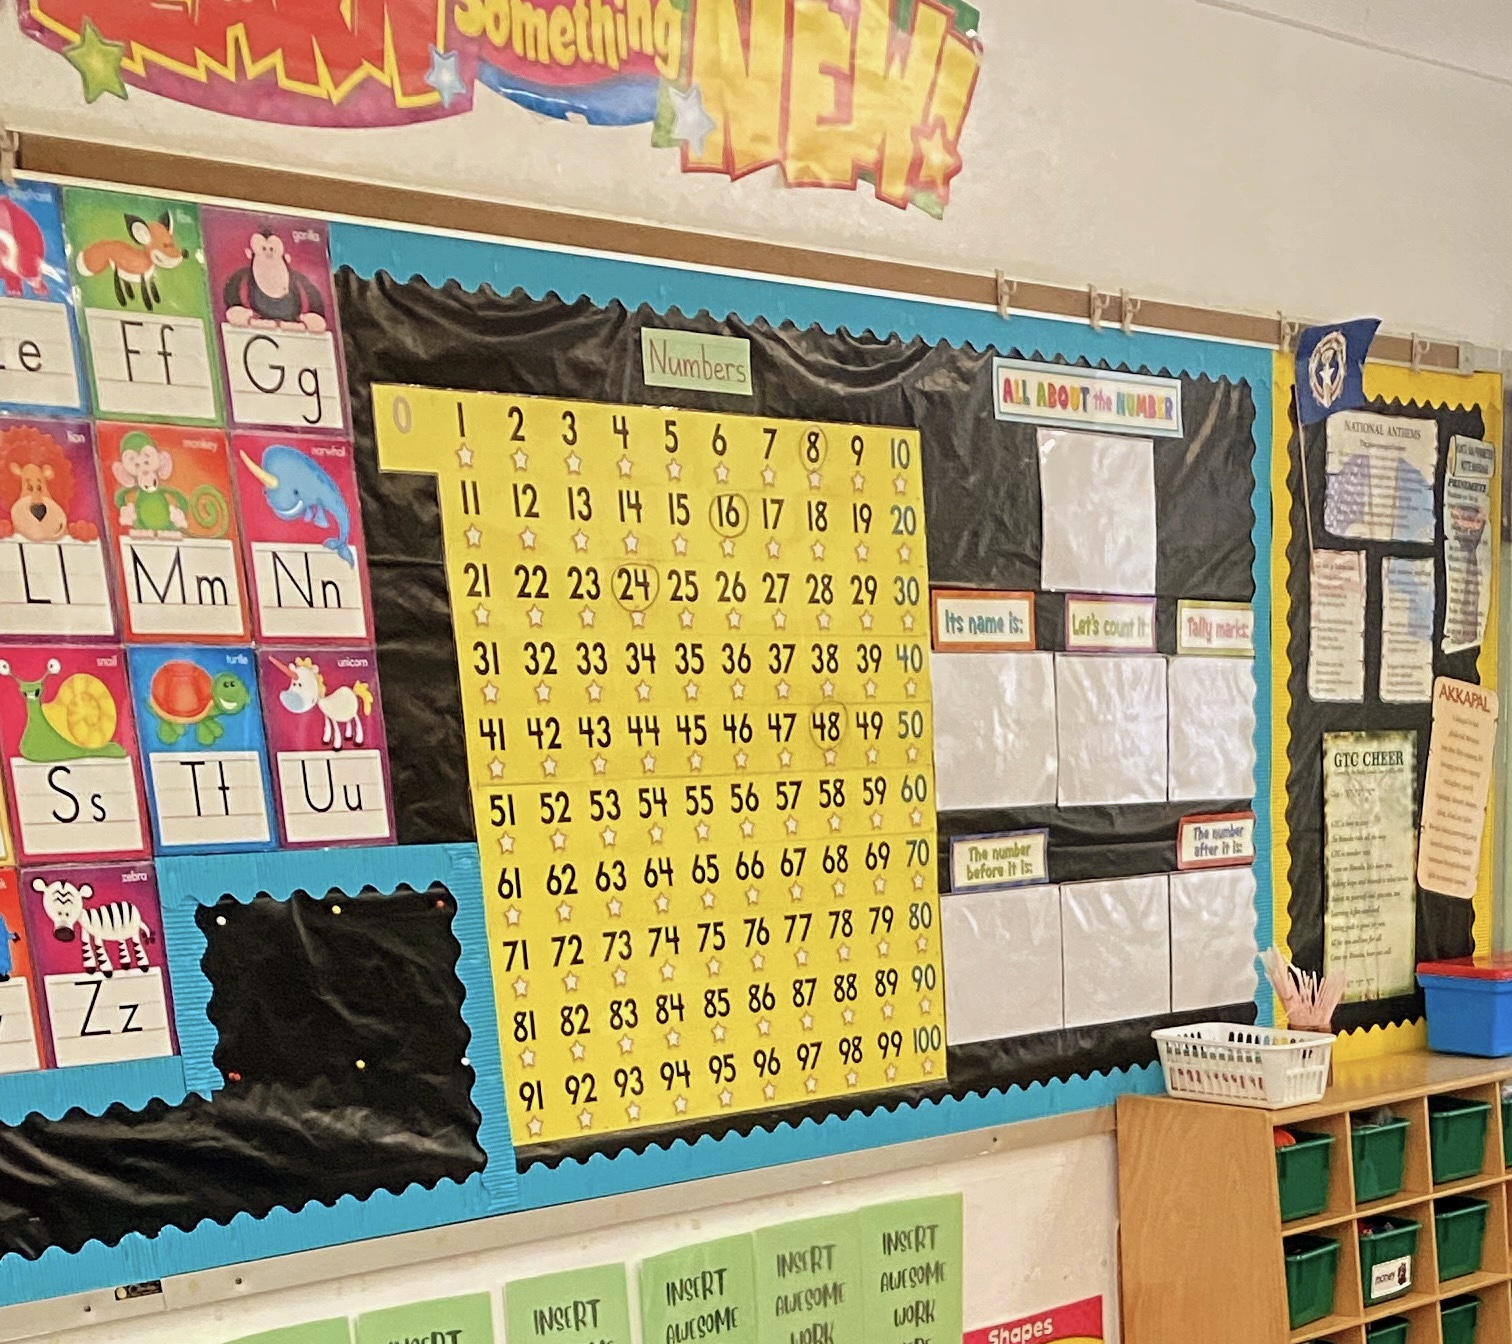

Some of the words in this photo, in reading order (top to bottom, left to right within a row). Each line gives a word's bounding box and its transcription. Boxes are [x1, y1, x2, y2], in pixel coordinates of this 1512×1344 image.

[243, 334, 323, 424] Gg
[649, 339, 748, 384] Numbers
[1003, 377, 1031, 406] ALL
[1036, 381, 1090, 413] ABOUT
[1094, 388, 1112, 413] the
[1116, 391, 1174, 420] NUMBER
[393, 395, 411, 433] 0
[457, 402, 465, 437] 1
[508, 406, 525, 441] 2
[562, 411, 577, 445] 3
[612, 415, 628, 449] 4
[665, 420, 678, 453] 5
[712, 424, 727, 456] 6
[762, 428, 777, 459] 7
[807, 431, 819, 463] 8
[851, 435, 864, 466] 9
[891, 438, 910, 470] 10
[1344, 420, 1385, 436] NATIONAL
[1387, 426, 1422, 440] ANTHEMS
[130, 544, 228, 606] Mm
[272, 551, 342, 608] Nn
[464, 563, 490, 597] 21
[514, 564, 549, 598] 22
[568, 566, 600, 600] 23
[617, 567, 650, 600] 24
[667, 570, 699, 603] 25
[716, 571, 746, 602] 26
[762, 572, 790, 604] 27
[806, 574, 833, 605] 28
[851, 575, 877, 605] 29
[894, 576, 919, 606] 30
[944, 609, 964, 633] Its
[968, 614, 1004, 634] name
[1008, 611, 1024, 634] is:
[1072, 613, 1099, 636] Let's
[1103, 616, 1134, 636] count
[1187, 617, 1212, 642] Tally
[1438, 682, 1491, 713] AKKAPAL
[479, 717, 506, 750] 41
[527, 717, 561, 749] 42
[578, 716, 611, 747] 43
[628, 715, 660, 746] 44
[677, 714, 707, 745] 45
[723, 714, 752, 744] 46
[768, 713, 796, 743] 47
[813, 712, 840, 742] 48
[856, 711, 883, 740] 49
[898, 710, 923, 739] 50
[1334, 752, 1359, 768] GTC
[1362, 750, 1404, 767] CHEER
[48, 765, 107, 824] Ss
[180, 760, 230, 816] Tt
[302, 759, 364, 813] Uu
[1193, 825, 1210, 841] The
[1212, 824, 1244, 839] number
[1194, 842, 1219, 857] after
[1222, 841, 1230, 855] it
[967, 861, 1003, 879] before
[1007, 861, 1017, 876] it
[1020, 860, 1033, 875] is:
[968, 845, 988, 861] The
[991, 843, 1031, 860] number
[121, 870, 148, 884] zebra
[503, 939, 529, 972] 71
[551, 934, 584, 967] 72
[602, 930, 632, 962] 73
[648, 926, 680, 957] 74
[697, 921, 726, 952] 75
[743, 917, 770, 948] 76
[784, 913, 813, 943] 77
[828, 909, 853, 939] 78
[869, 905, 894, 935] 79
[908, 901, 932, 930] 80
[75, 980, 143, 1037] Zz
[519, 1080, 544, 1112] 91
[565, 1073, 597, 1105] 92
[614, 1066, 644, 1098] 93
[660, 1060, 690, 1091] 94
[708, 1053, 736, 1084] 95
[753, 1047, 781, 1078] 96
[796, 1041, 822, 1071] 97
[838, 1036, 863, 1065] 98
[877, 1030, 902, 1059] 99
[913, 1024, 941, 1054] 100
[882, 1224, 939, 1256] INSERT
[776, 1244, 837, 1279] INSERT
[880, 1260, 947, 1293] AWESOME
[1374, 1270, 1396, 1286] money
[666, 1268, 728, 1307] INSERT
[775, 1281, 847, 1317] AWESOME
[533, 1299, 600, 1335] INSERT
[894, 1299, 936, 1328] WORK
